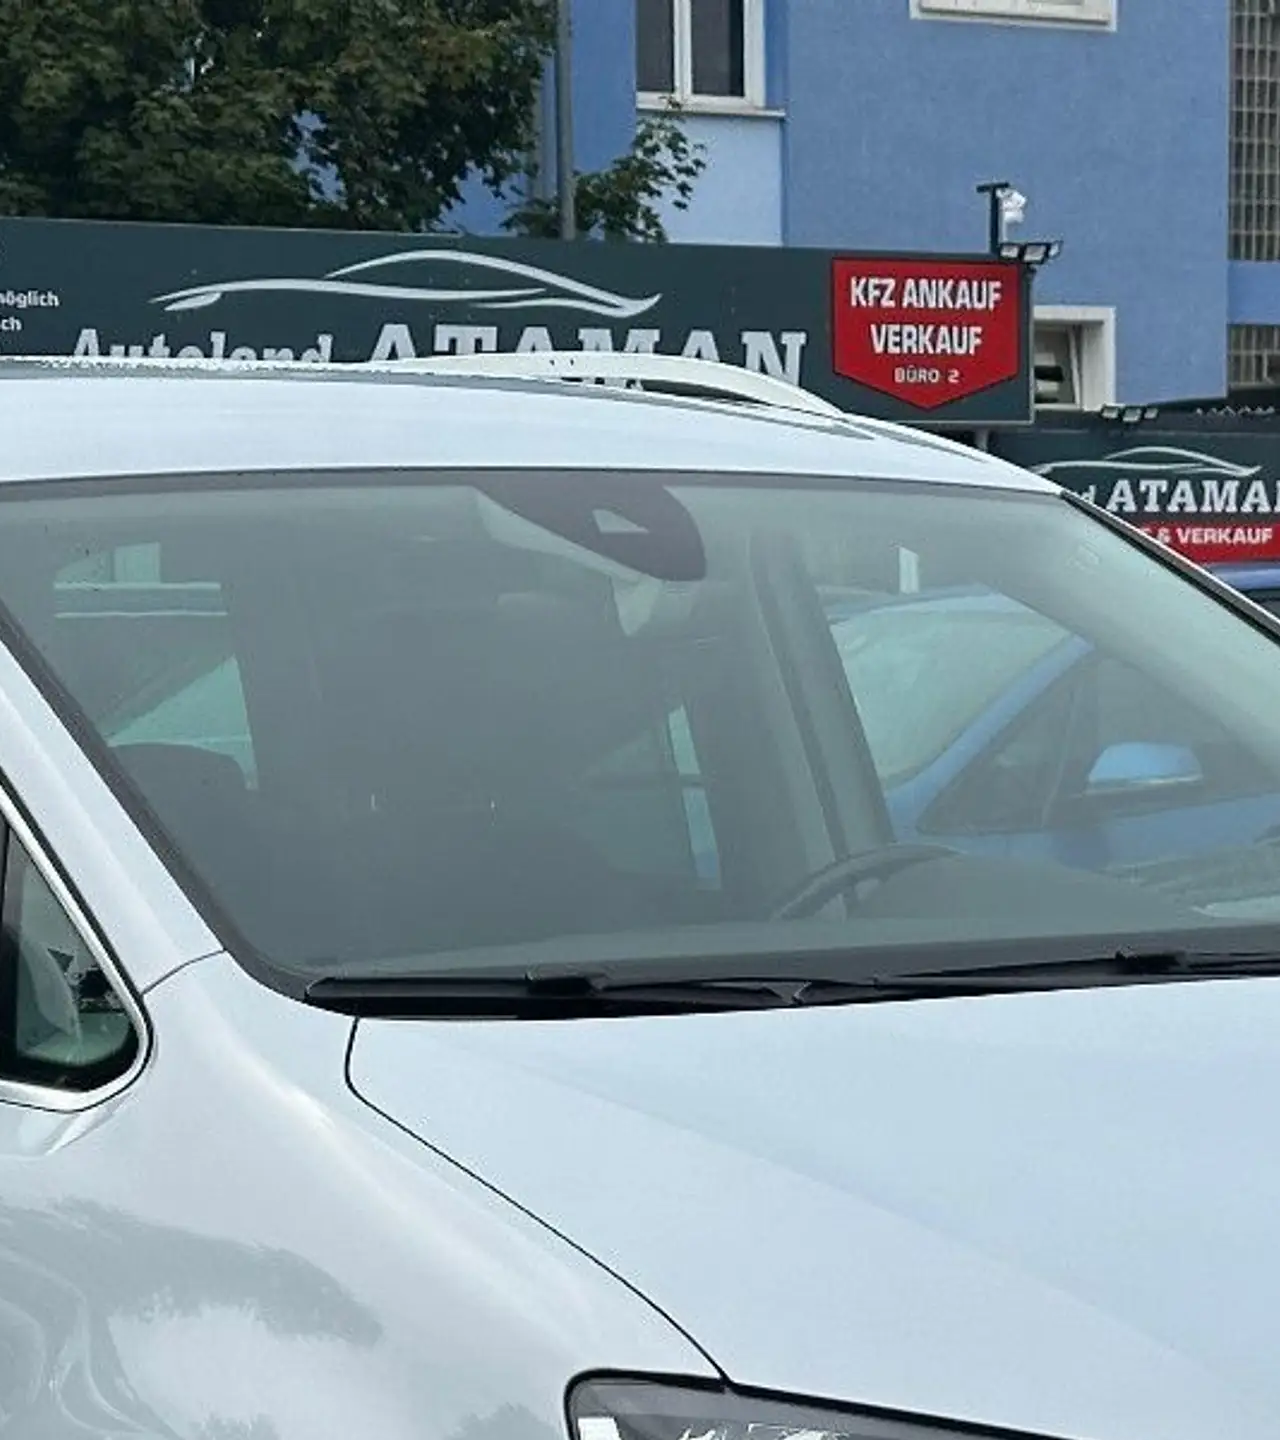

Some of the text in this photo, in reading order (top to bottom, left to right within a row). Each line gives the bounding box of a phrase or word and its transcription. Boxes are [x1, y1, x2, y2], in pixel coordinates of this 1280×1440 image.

[850, 276, 1002, 311] KFZ ANKAUF
[870, 323, 983, 355] VERKAUF
[894, 365, 961, 384] BÜRO 2
[1177, 527, 1274, 545] VERKAUF
